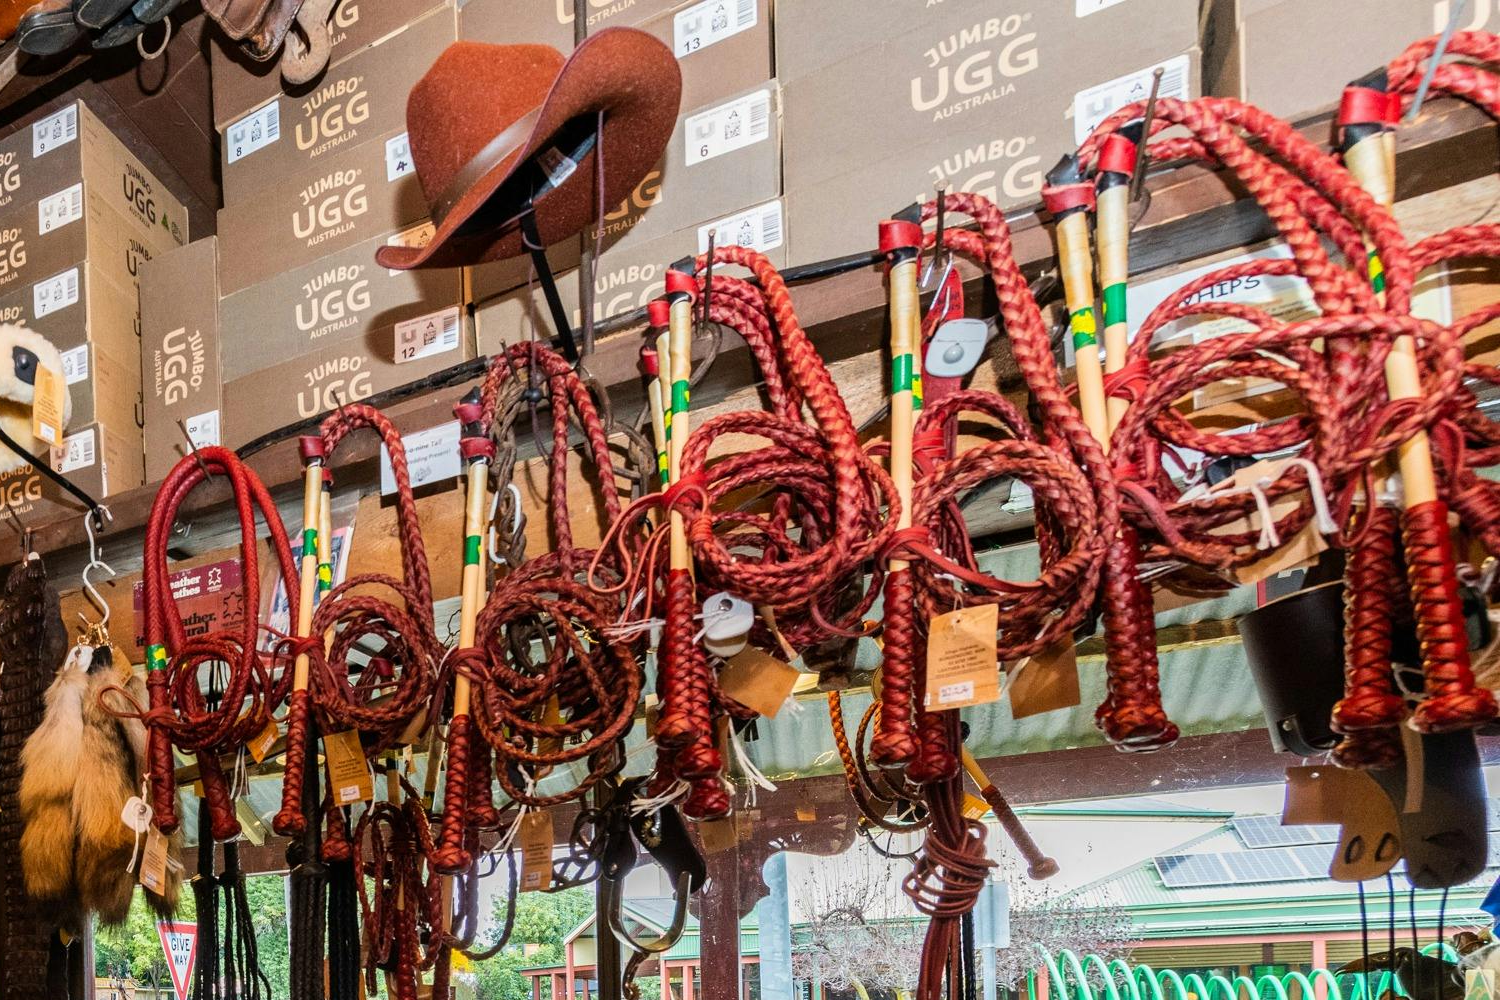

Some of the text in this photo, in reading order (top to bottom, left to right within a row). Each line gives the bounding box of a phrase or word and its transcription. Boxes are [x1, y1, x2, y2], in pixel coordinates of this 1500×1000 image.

[684, 37, 701, 53] 13
[924, 14, 1021, 69] JUMBO
[910, 32, 1039, 113] UGG
[302, 77, 358, 118] JUMBO
[933, 83, 1016, 122] AUSTRALIA
[295, 90, 370, 151] UGG
[40, 143, 46, 152] 9
[236, 147, 242, 157] 8
[310, 129, 358, 159] AUSTRALIA
[700, 144, 709, 158] 6
[929, 136, 1026, 185] JUMBO
[126, 163, 152, 195] JUMBO
[299, 169, 357, 206] JUMBO
[123, 173, 156, 225] UGG
[292, 183, 368, 239] UGG
[45, 220, 51, 229] 6
[307, 221, 356, 248] AUSTRALIA
[302, 265, 360, 299] JUMBO
[295, 279, 371, 331] UGG
[310, 316, 359, 340] AUSTRALIA
[163, 327, 188, 406] UGG
[188, 330, 205, 388] JUMBO
[401, 347, 416, 360] 12
[154, 350, 162, 397] AUSTRALIA
[304, 356, 362, 387] JUMBO
[297, 371, 373, 419] UGG
[171, 937, 190, 951] GIVE
[175, 955, 188, 965] WAY
